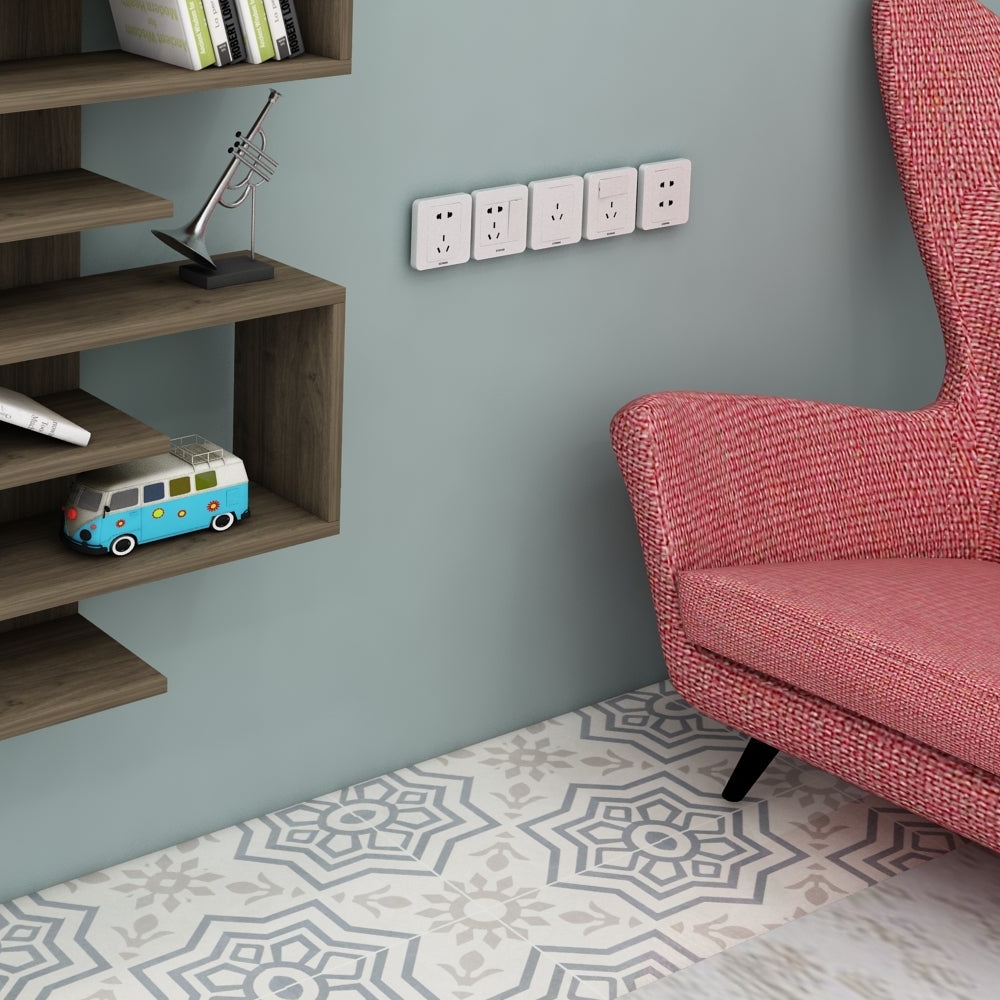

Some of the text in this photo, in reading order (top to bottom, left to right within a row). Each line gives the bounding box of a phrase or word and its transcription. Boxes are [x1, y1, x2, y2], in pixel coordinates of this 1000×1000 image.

[146, 0, 178, 21] Modern
[226, 22, 242, 59] ROBERT
[285, 19, 300, 54] ROBERT
